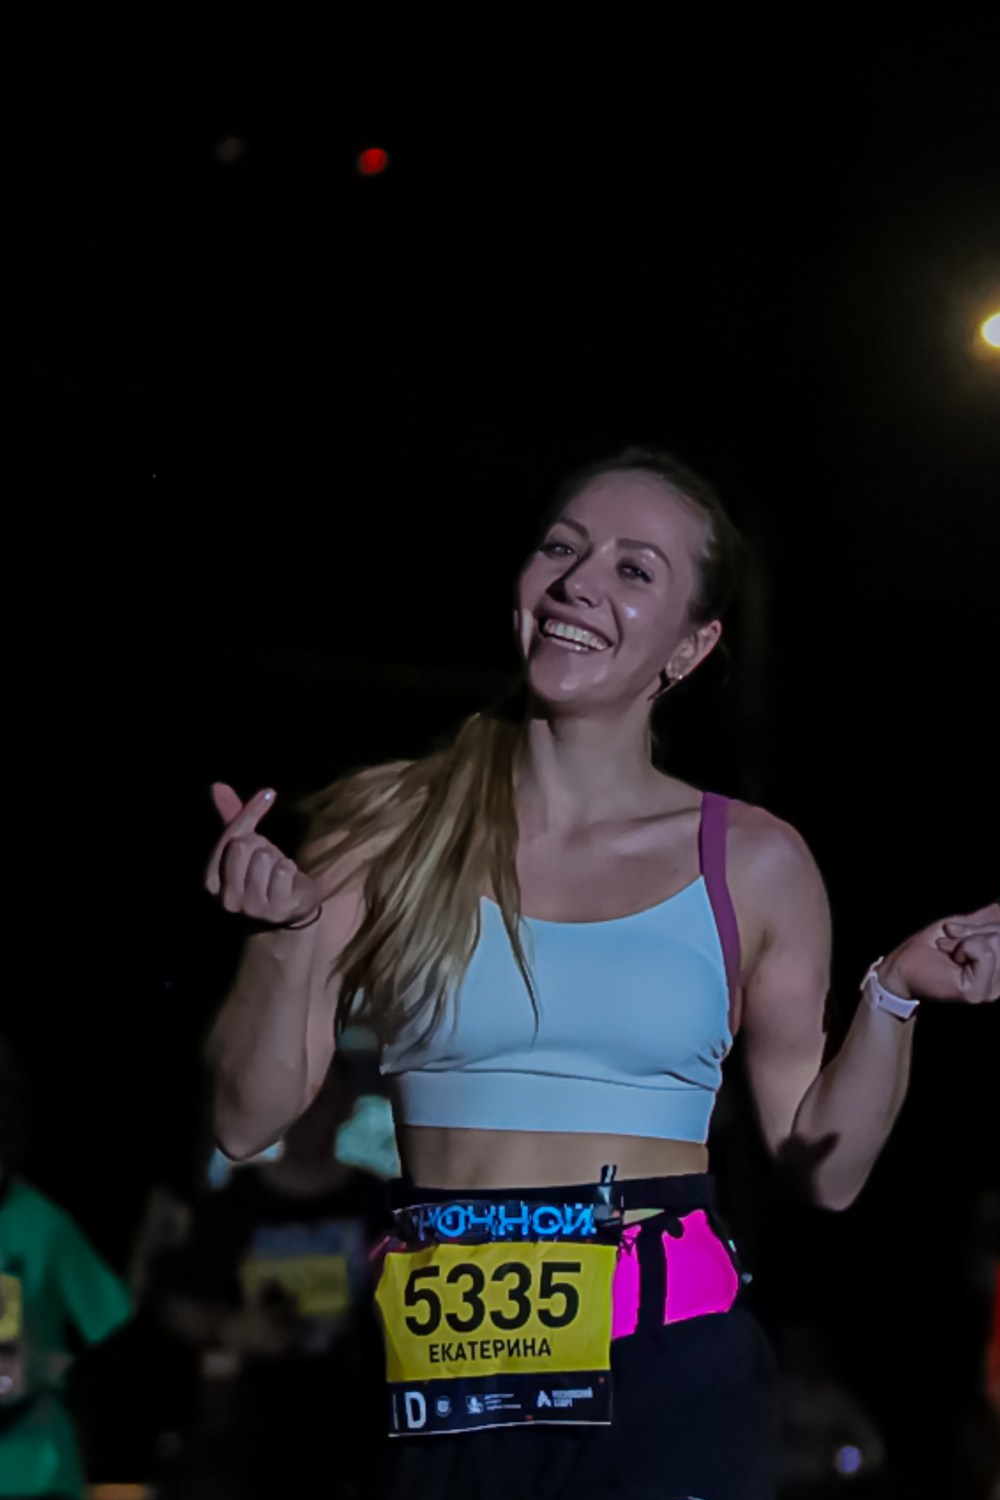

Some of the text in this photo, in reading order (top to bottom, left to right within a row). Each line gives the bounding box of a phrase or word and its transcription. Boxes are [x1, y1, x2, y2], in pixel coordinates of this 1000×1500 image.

[404, 1261, 581, 1336] 5335
[429, 1337, 552, 1363] ЕКАТЕРИНА
[403, 1390, 427, 1430] D
